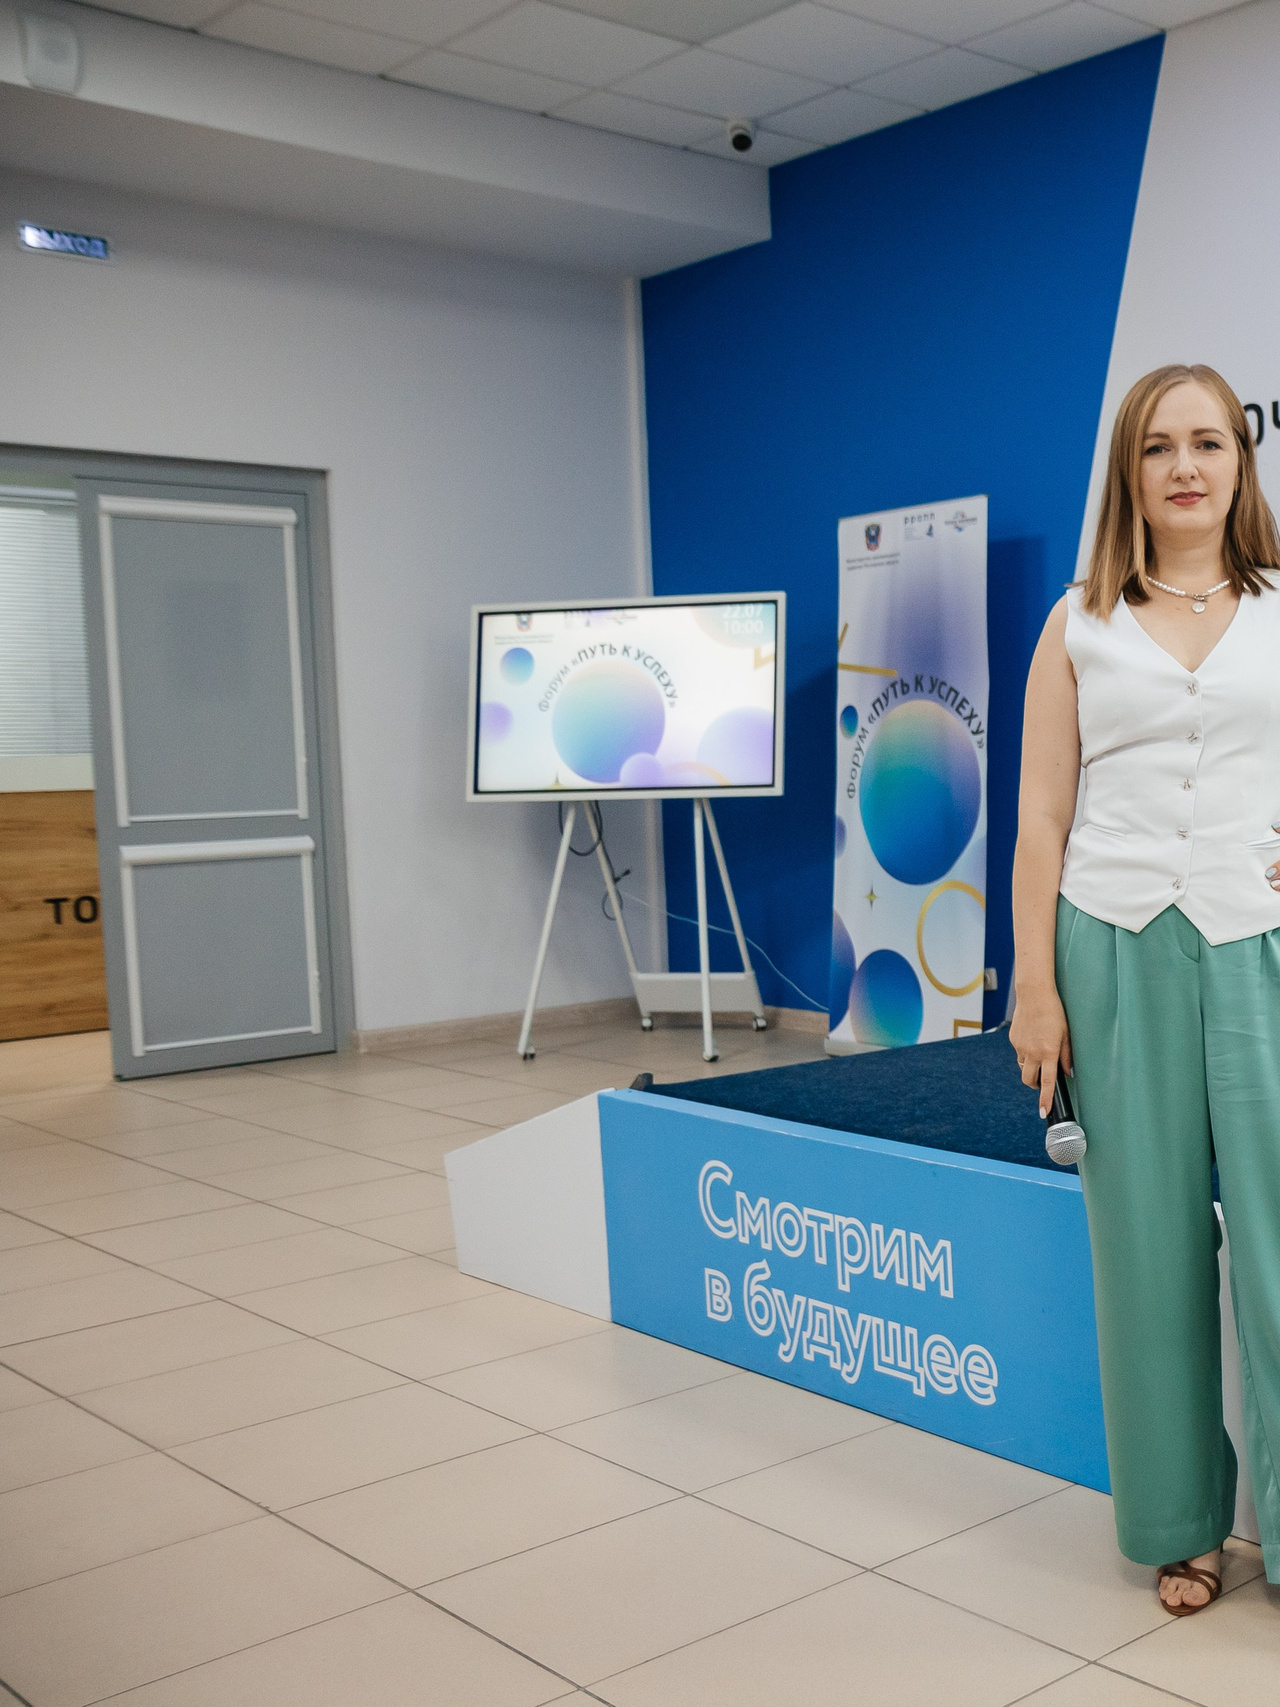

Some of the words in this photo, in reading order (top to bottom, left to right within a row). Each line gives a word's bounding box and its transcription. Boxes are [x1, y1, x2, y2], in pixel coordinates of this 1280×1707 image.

[24, 226, 107, 259] ЫХОД
[723, 619, 764, 634] 10:00
[538, 665, 571, 712] Форум
[571, 643, 617, 666] «ПУТЬ
[621, 644, 632, 657] К
[634, 647, 678, 708] УСПЕХУ»
[846, 726, 869, 800] Форум
[867, 678, 911, 725] «ПУТЬ
[914, 673, 925, 693] К
[929, 675, 985, 750] УСПЕХУ»
[698, 1159, 954, 1299] Смотрим
[704, 1267, 733, 1322] в
[743, 1258, 999, 1406] будущее
